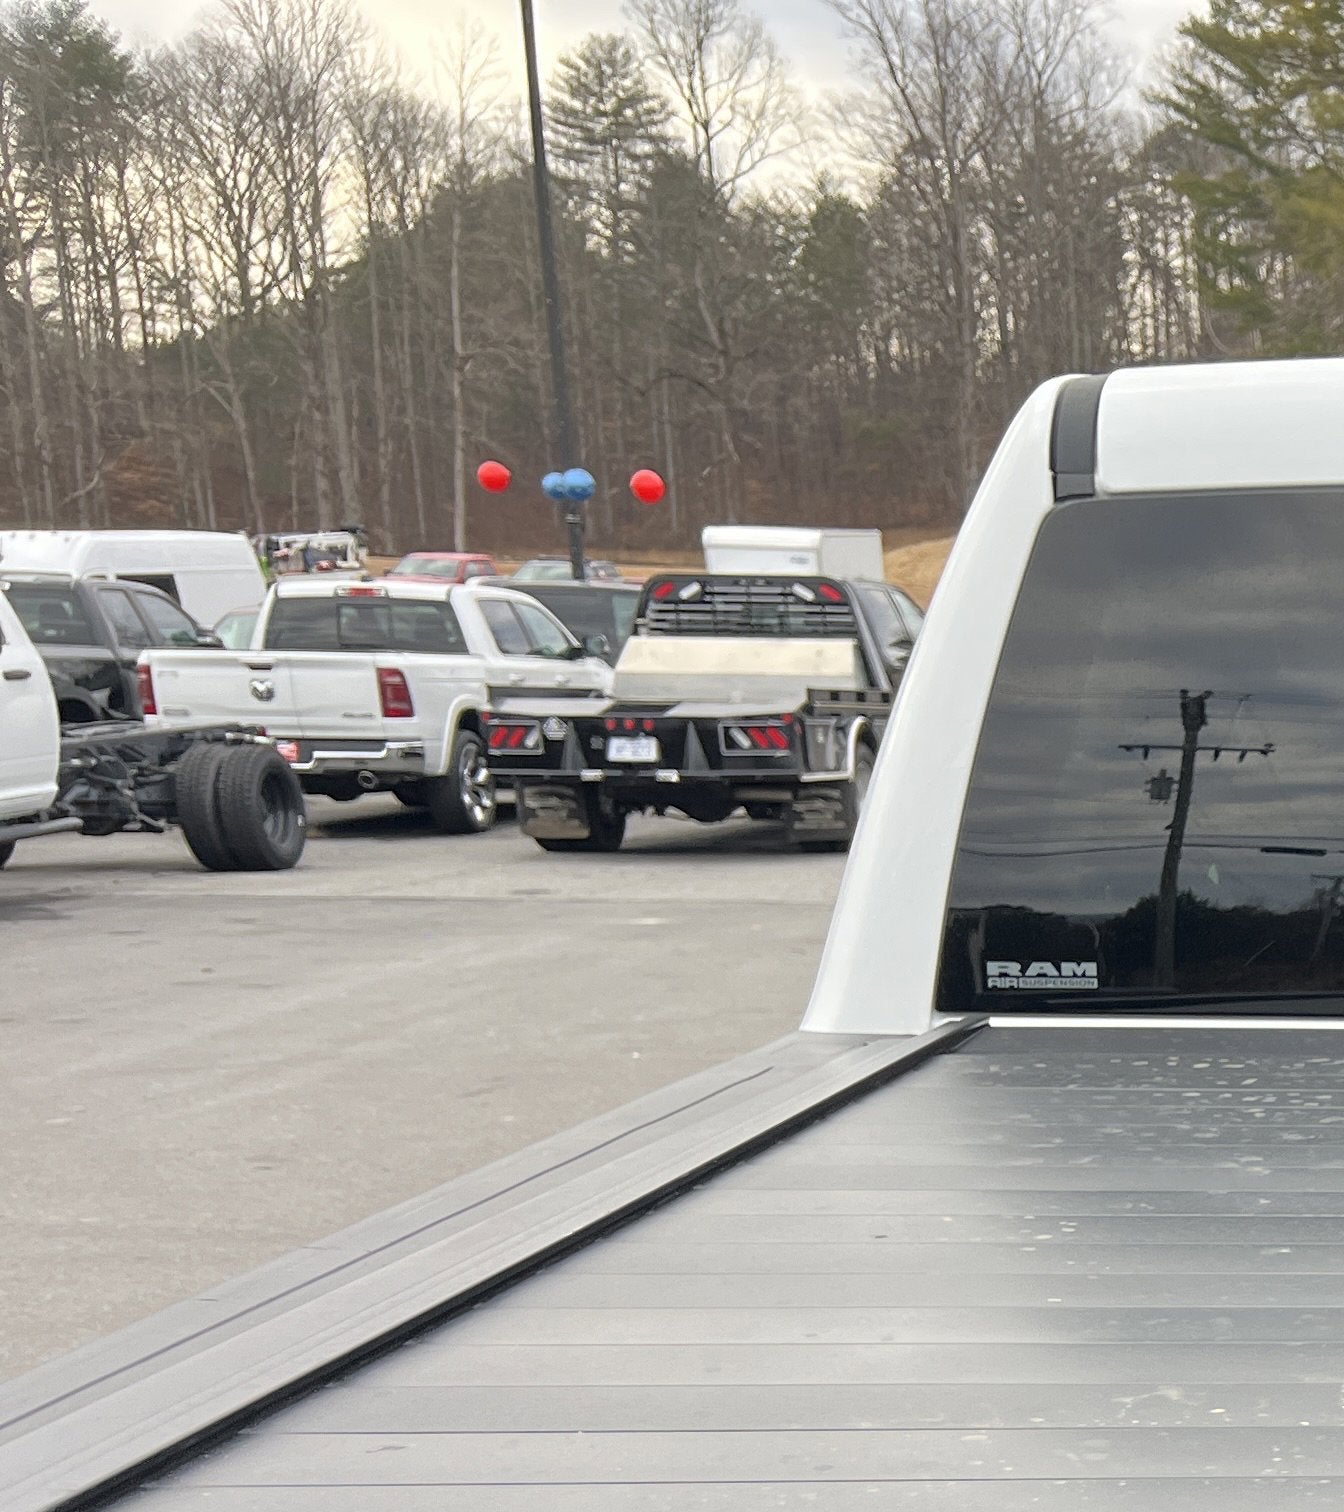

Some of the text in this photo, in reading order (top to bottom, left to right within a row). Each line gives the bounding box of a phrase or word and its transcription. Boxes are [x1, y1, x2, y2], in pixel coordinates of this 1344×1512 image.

[986, 961, 1098, 977] RAM
[988, 977, 1097, 988] AIR SUSPENSION
